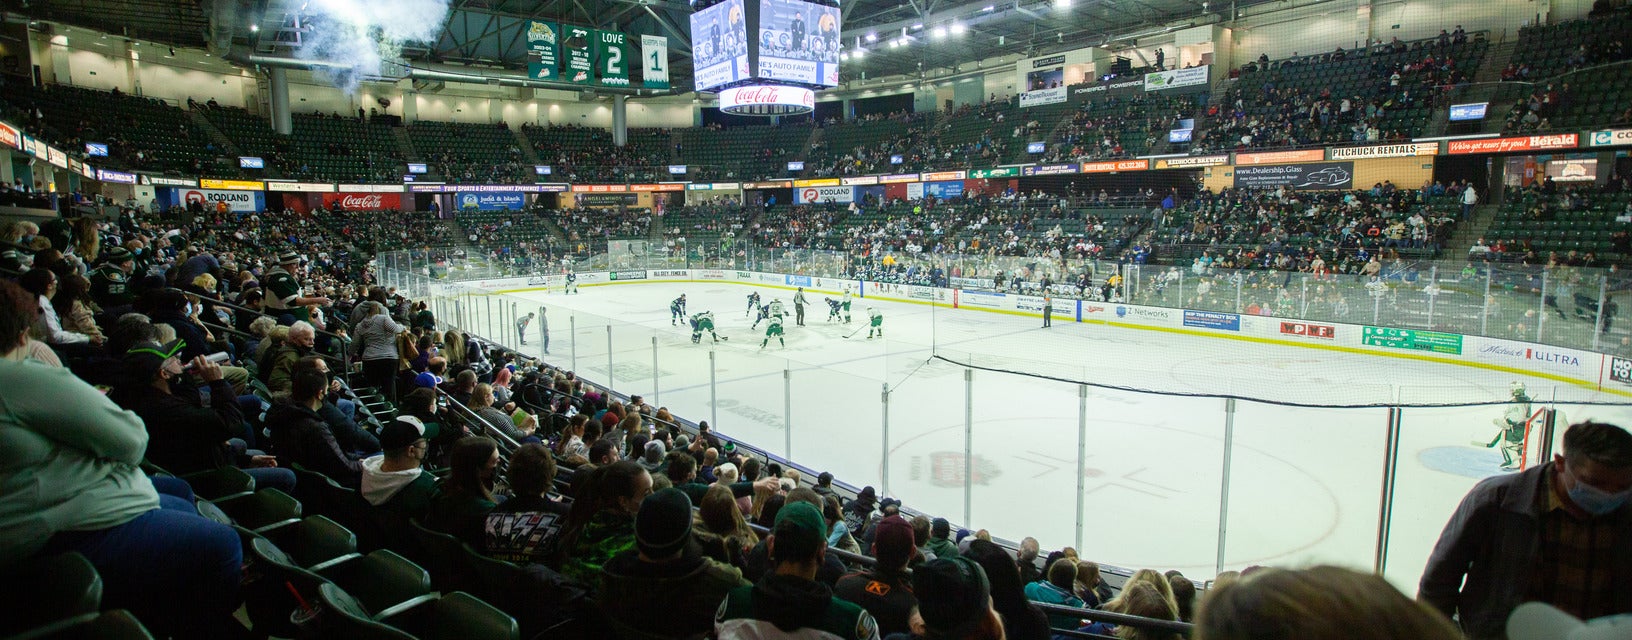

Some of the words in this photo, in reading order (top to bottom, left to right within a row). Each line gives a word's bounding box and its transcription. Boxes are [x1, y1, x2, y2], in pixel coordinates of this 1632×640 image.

[602, 33, 623, 44] LOVE
[607, 46, 622, 74] 2
[651, 50, 662, 71] 1
[1074, 86, 1106, 94] POWERADE
[1109, 80, 1144, 88] POWERADE
[735, 87, 779, 104] Coca-Cola
[1451, 142, 1470, 151] We've
[1470, 143, 1482, 153] got
[1498, 139, 1510, 152] for
[1508, 140, 1527, 152] you!
[1530, 134, 1574, 147] Herald
[1333, 148, 1375, 156] PILCHUCK
[1378, 145, 1416, 154] RENTALS
[1236, 166, 1302, 175] www.Dealership.Glass
[208, 194, 249, 202] RODLAND
[342, 194, 382, 208] Coca-Cola
[108, 284, 125, 293] 22
[1135, 309, 1168, 318] Networks
[1479, 345, 1524, 357] Michelob
[1536, 351, 1579, 366] ULTRA
[485, 511, 562, 541] KISS
